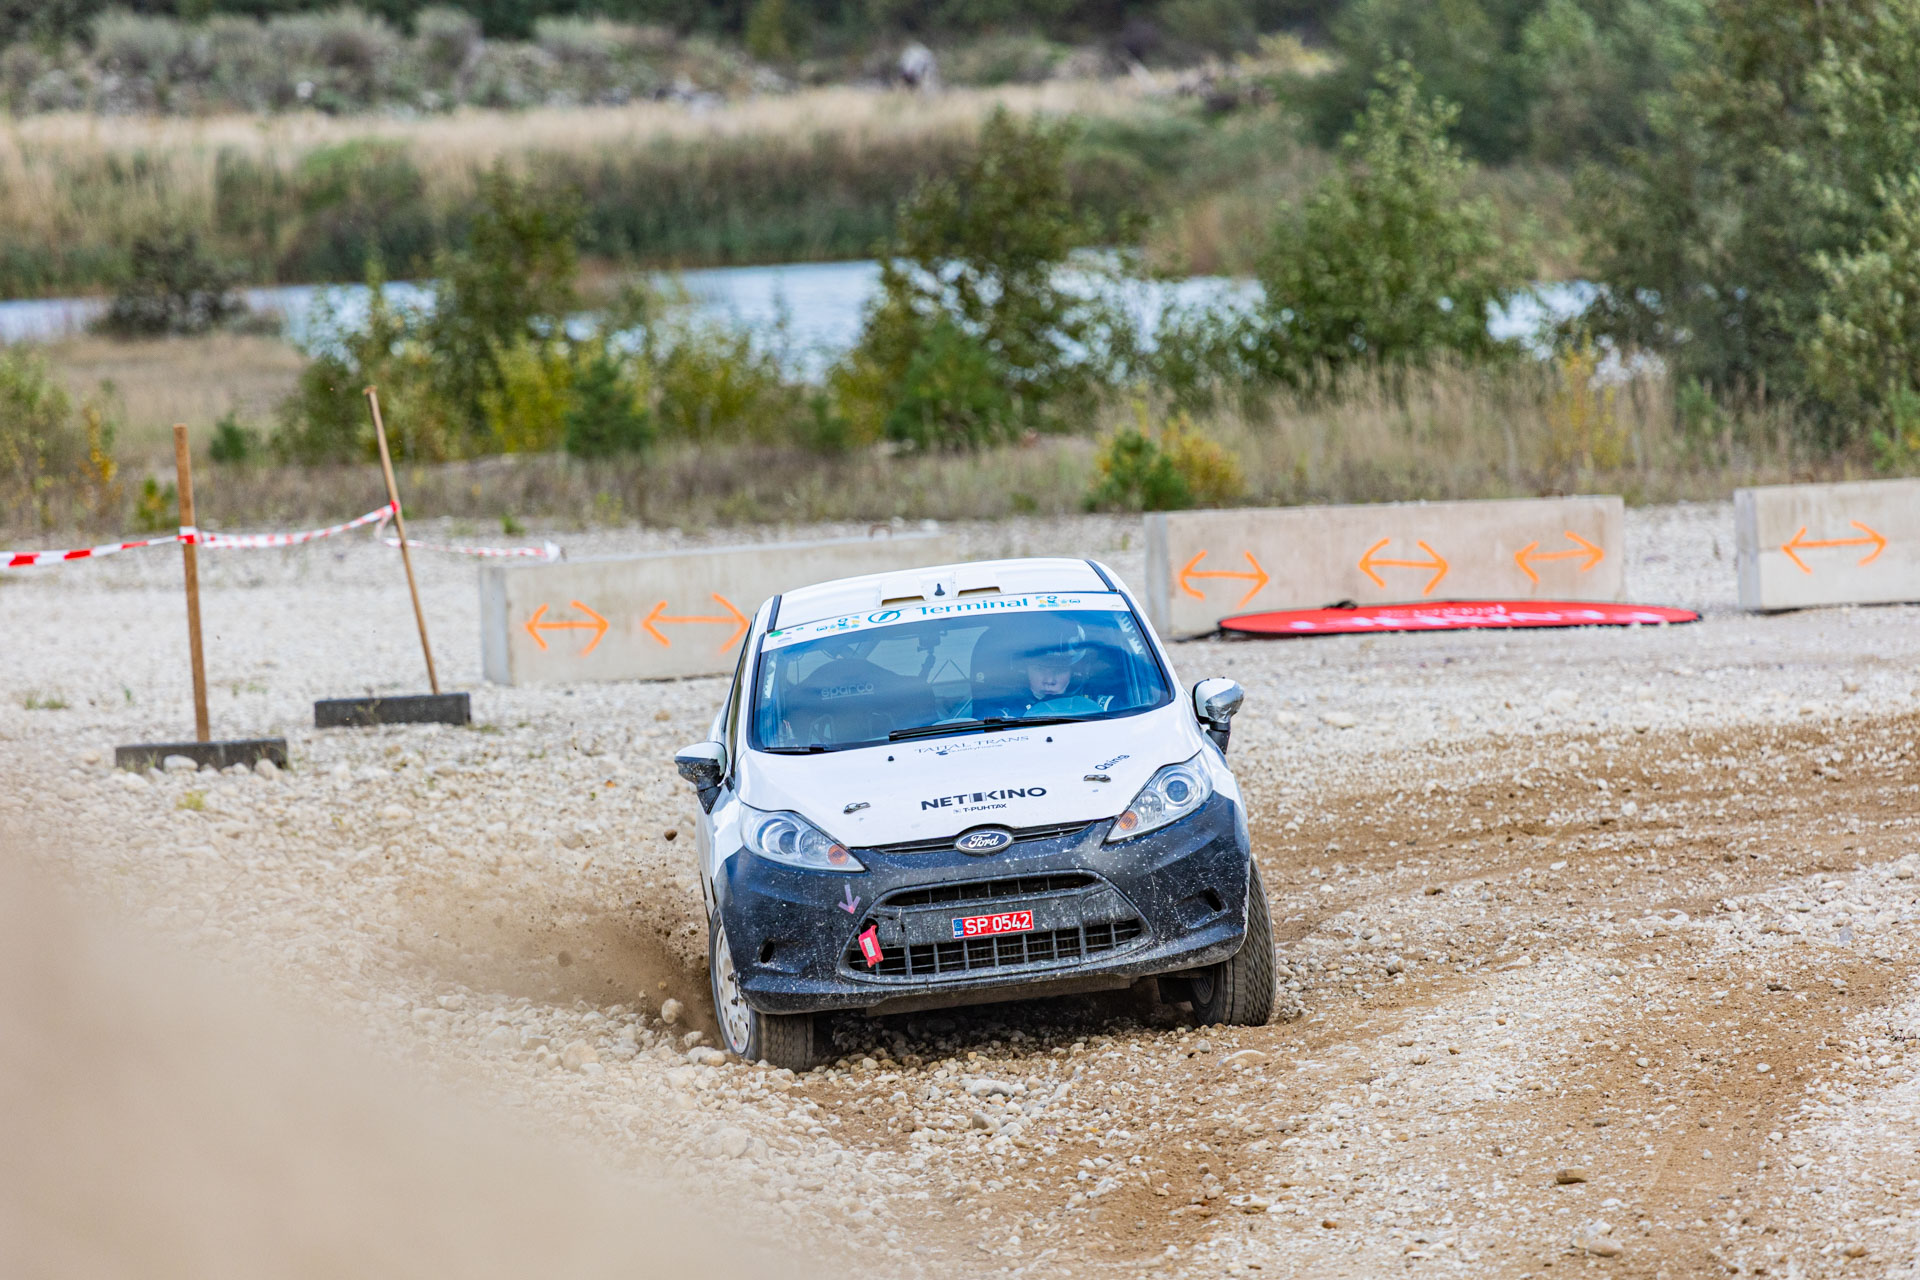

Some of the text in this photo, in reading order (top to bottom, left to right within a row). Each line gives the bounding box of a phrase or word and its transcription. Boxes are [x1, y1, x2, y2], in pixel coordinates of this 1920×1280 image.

[916, 598, 1028, 615] Terminal
[821, 683, 875, 700] sparco
[975, 736, 1029, 746] TRANS
[963, 803, 1007, 812] T-PUHTAX
[968, 833, 999, 848] Ford
[965, 913, 1031, 934] SP 0542
